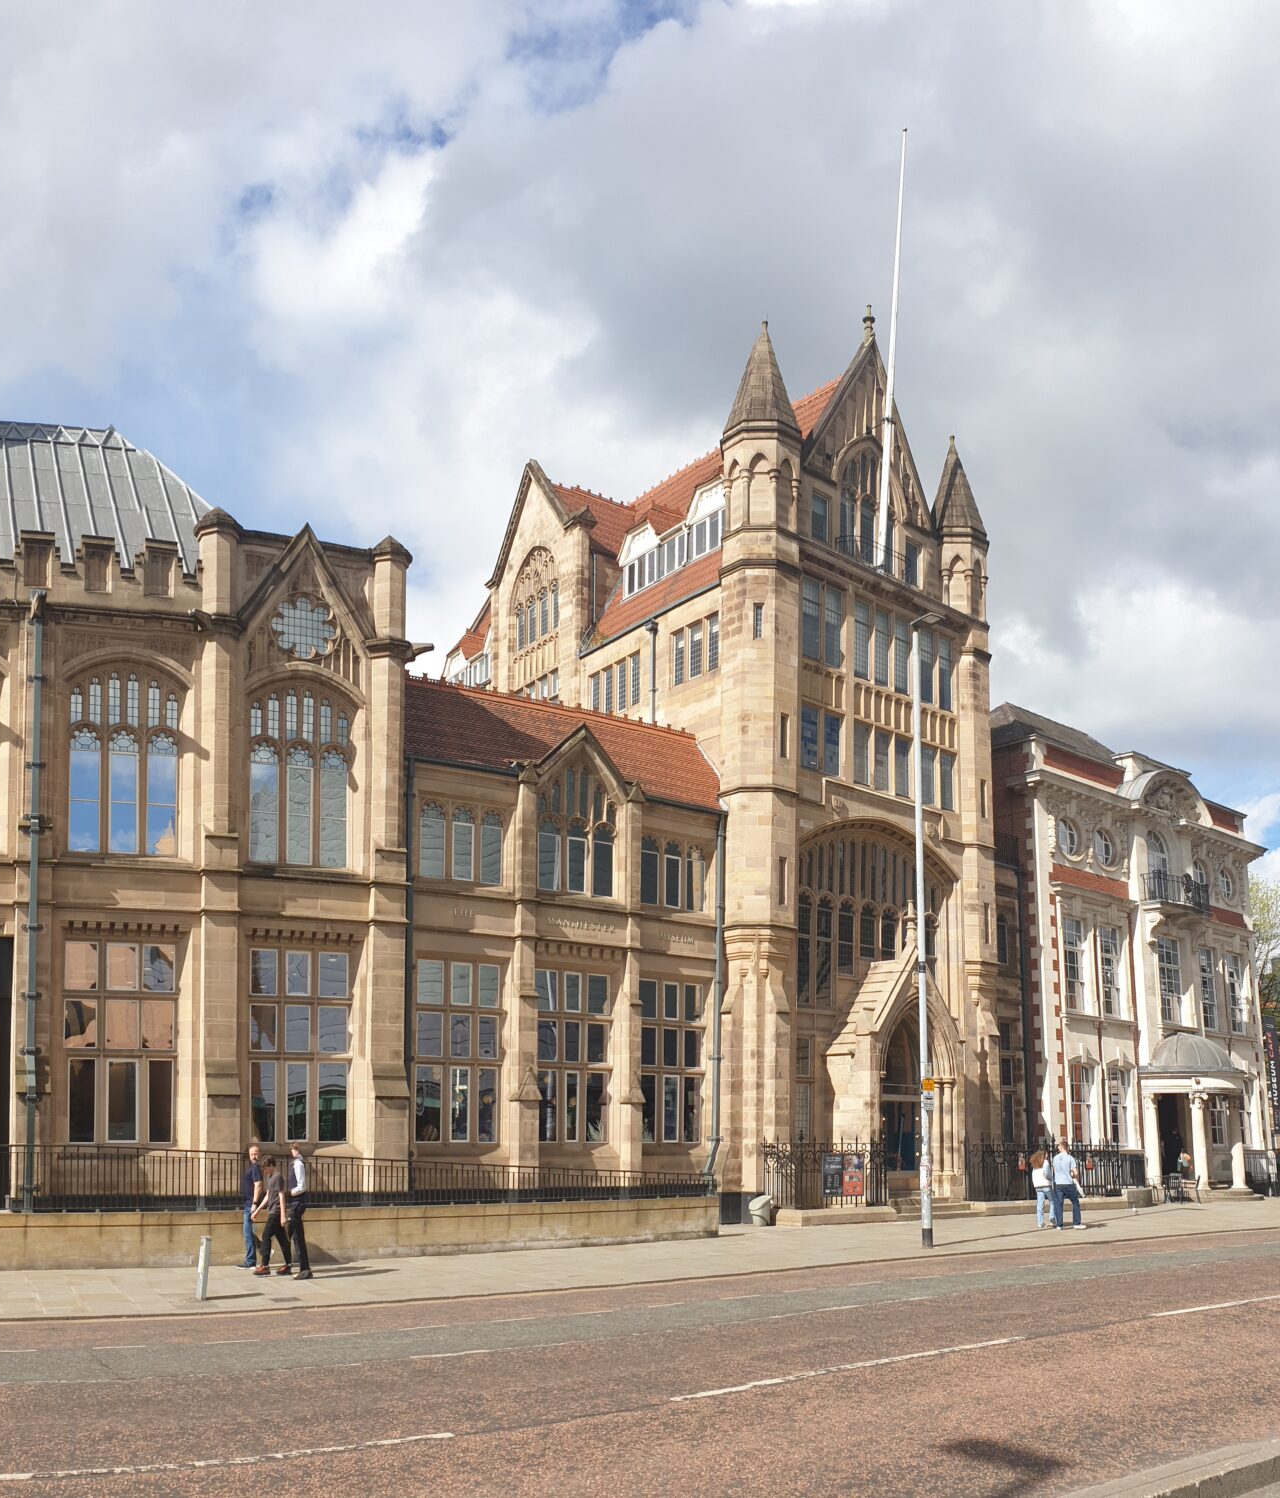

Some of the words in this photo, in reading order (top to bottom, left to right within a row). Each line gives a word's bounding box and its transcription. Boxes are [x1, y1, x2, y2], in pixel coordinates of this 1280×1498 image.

[450, 907, 475, 918] THE
[547, 917, 616, 934] MANCHESTER
[658, 931, 695, 945] MUSEUM
[1270, 1061, 1279, 1105] MUSEUM
